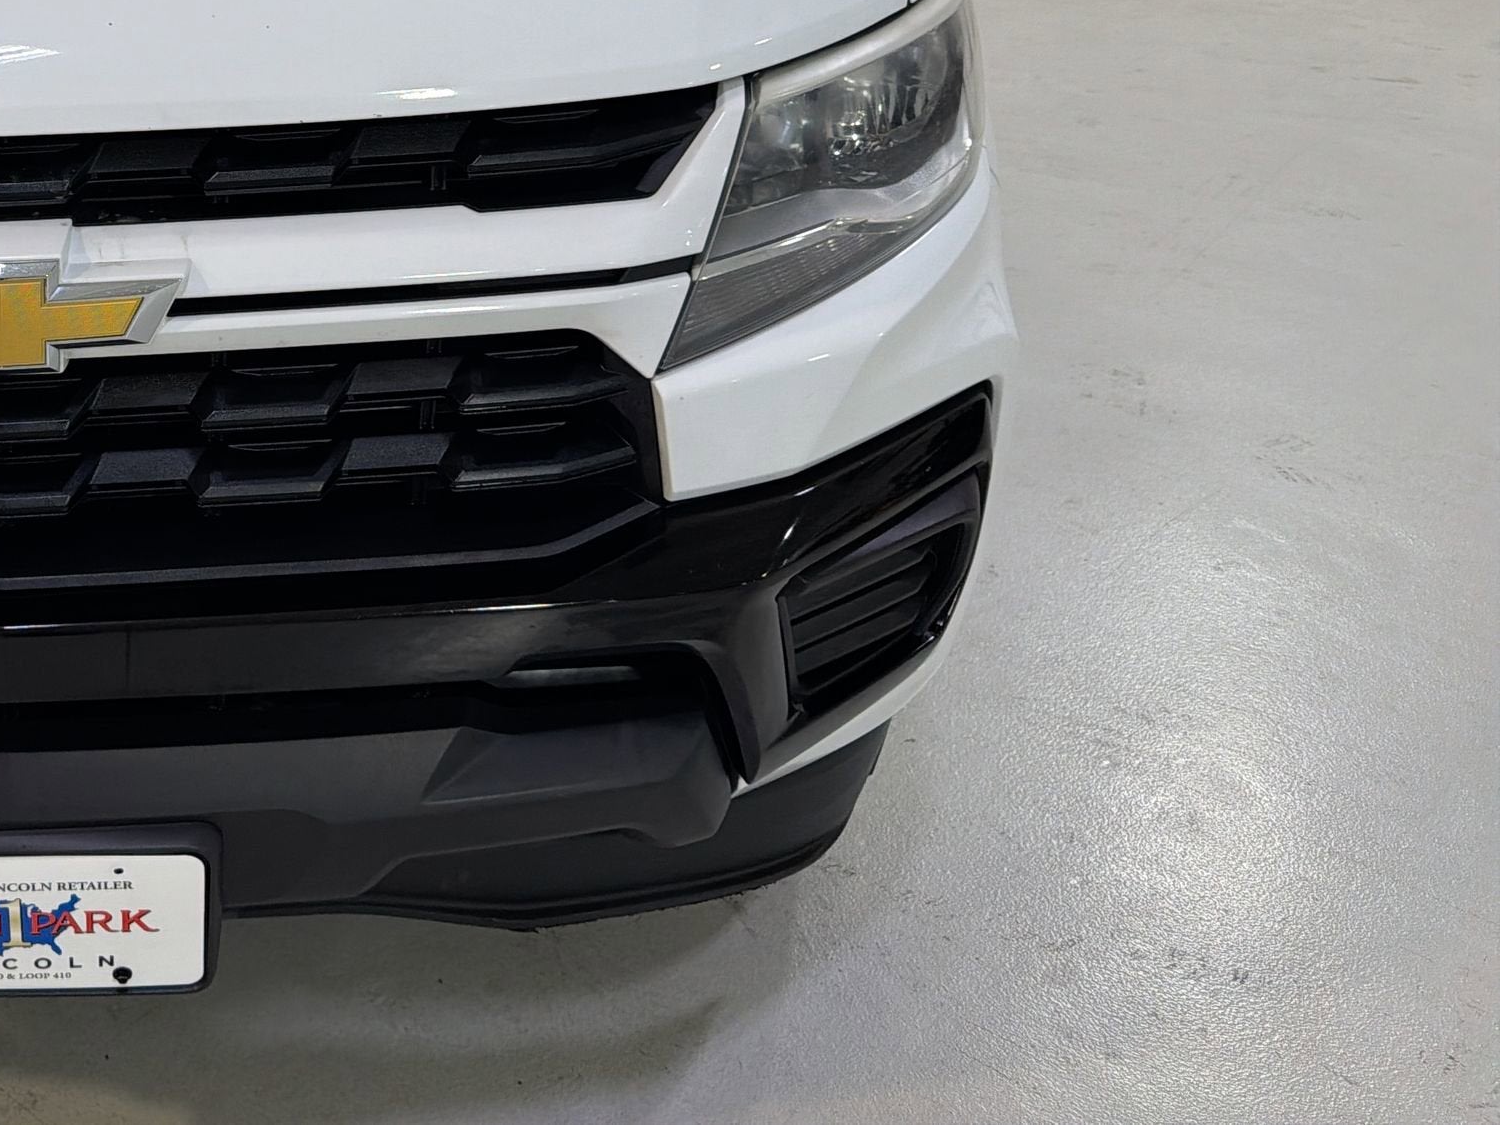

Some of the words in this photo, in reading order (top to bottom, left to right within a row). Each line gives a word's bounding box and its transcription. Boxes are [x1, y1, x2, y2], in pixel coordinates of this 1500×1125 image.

[57, 881, 134, 891] RETAILER
[30, 908, 160, 936] PARK
[6, 972, 16, 980] &
[19, 972, 50, 980] LOOP
[52, 971, 72, 979] 410
